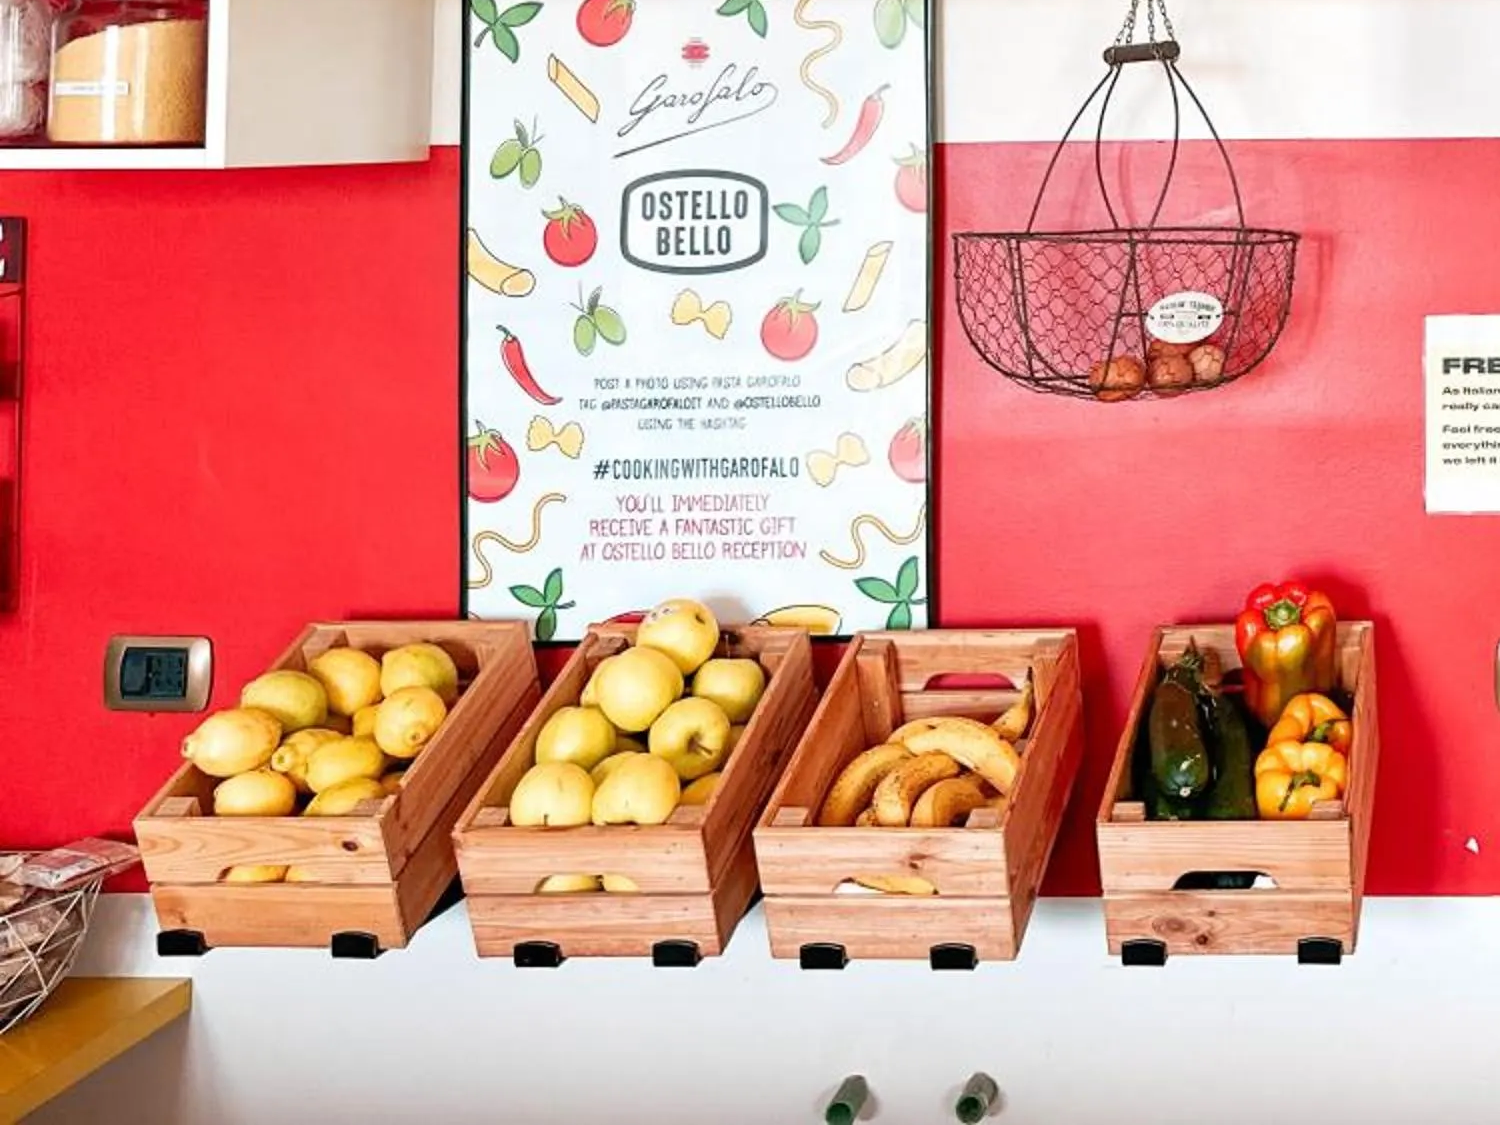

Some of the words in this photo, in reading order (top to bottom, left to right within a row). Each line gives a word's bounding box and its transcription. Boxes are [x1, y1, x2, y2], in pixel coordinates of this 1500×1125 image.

[617, 63, 766, 138] Garofalo
[641, 189, 749, 221] OSTELLO
[656, 225, 732, 256] BELLO
[1442, 386, 1460, 395] As
[1463, 386, 1500, 395] Italian
[708, 397, 729, 409] AND
[1442, 402, 1479, 412] really
[1442, 424, 1471, 434] Feel
[592, 457, 800, 480] #COOKINGWITHGAROFALO
[1465, 456, 1486, 465] left
[616, 493, 665, 513] YOU'LL
[671, 493, 771, 512] IMMEDIATELY
[589, 518, 653, 537] RECEIVE
[659, 519, 669, 536] A
[675, 518, 754, 537] FANTASTIC
[760, 516, 797, 535] GIFT
[579, 542, 597, 562] AT
[601, 541, 666, 561] OSTELLO
[671, 541, 716, 560] BELLO
[722, 540, 808, 561] RECEPTION
